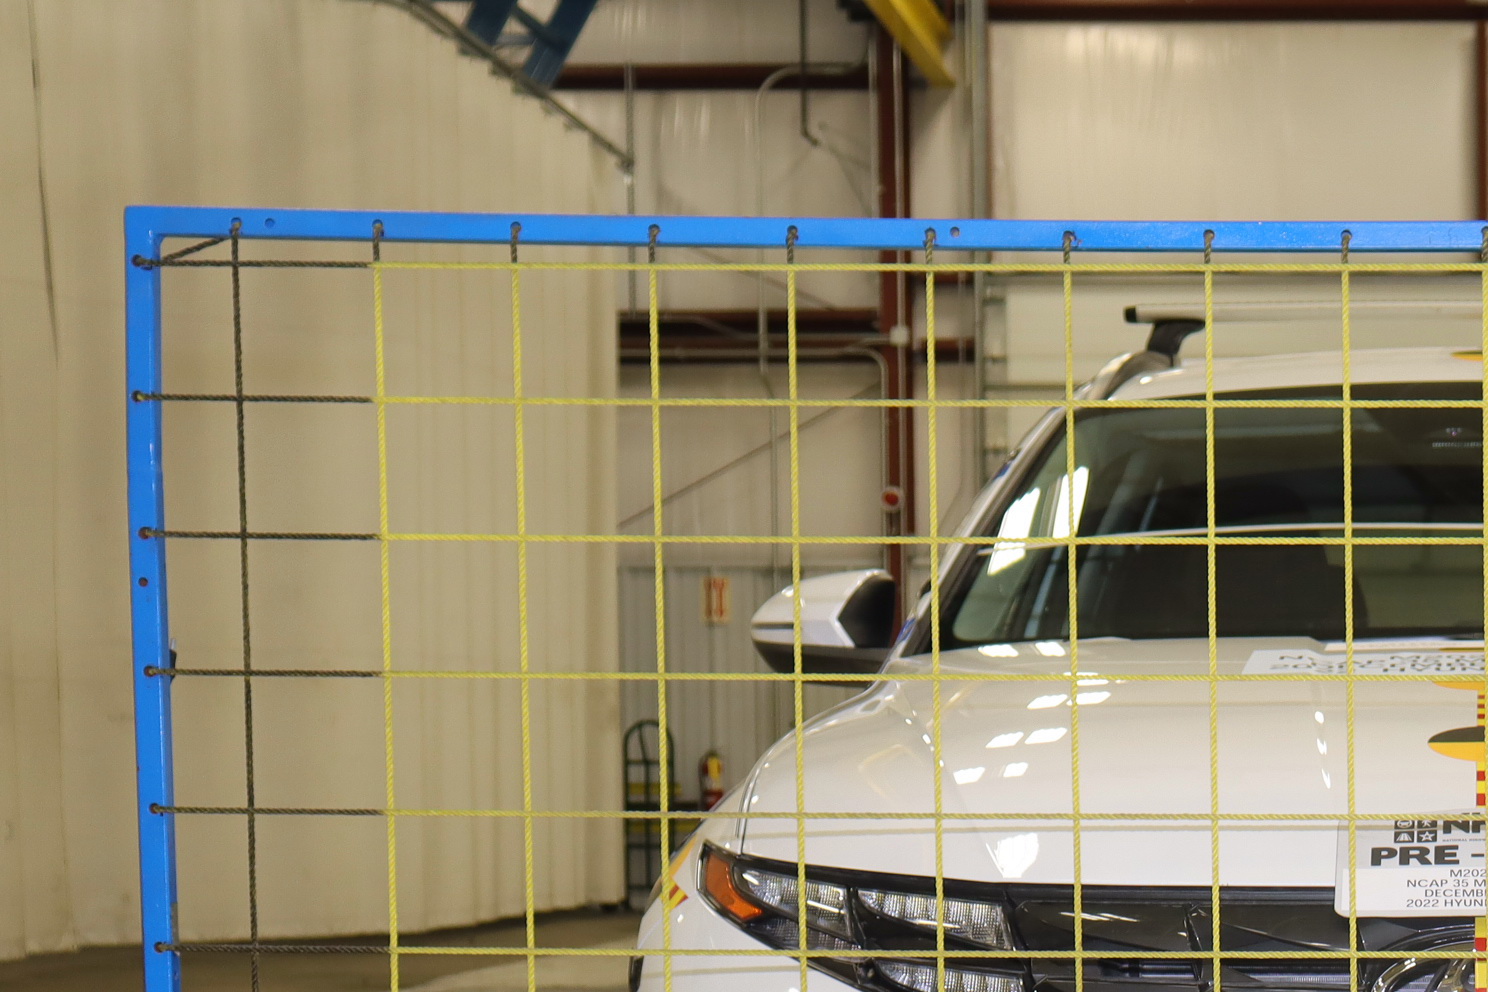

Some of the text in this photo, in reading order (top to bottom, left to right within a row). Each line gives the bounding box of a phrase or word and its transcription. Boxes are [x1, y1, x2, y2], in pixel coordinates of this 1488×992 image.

[1370, 845, 1460, 866] PRE
[1406, 879, 1448, 888] NCAP
[1453, 879, 1469, 888] 35
[1406, 898, 1439, 908] 2022
